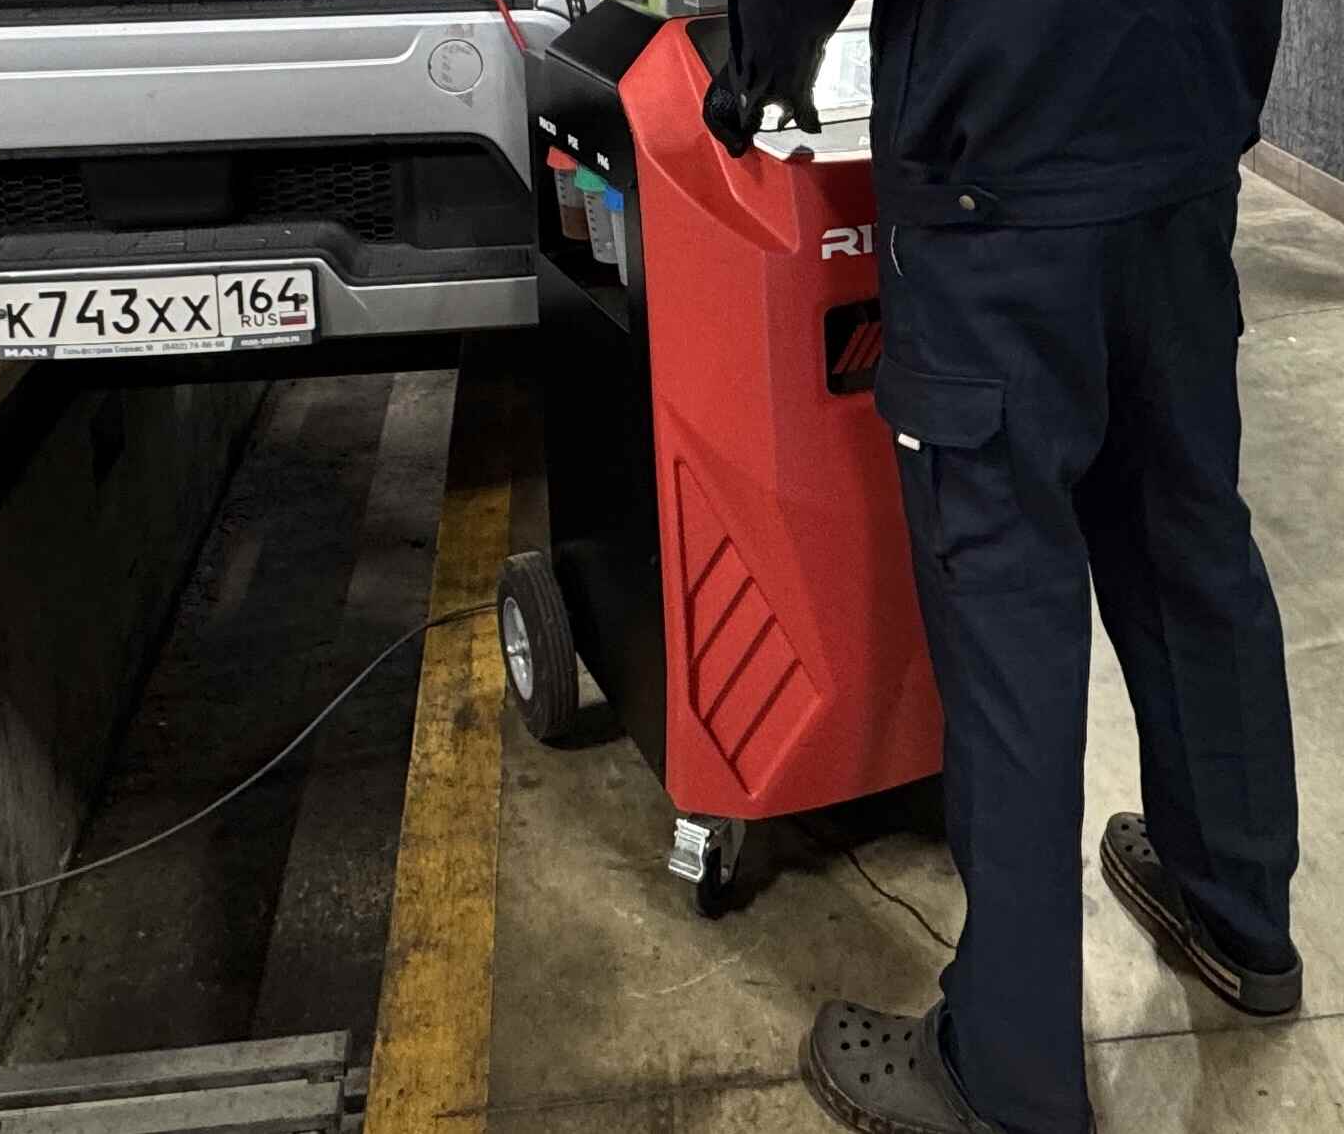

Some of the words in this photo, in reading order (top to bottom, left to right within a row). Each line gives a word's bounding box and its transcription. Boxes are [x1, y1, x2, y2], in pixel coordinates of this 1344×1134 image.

[223, 276, 301, 315] 164
[240, 312, 278, 328] RUS
[3, 347, 48, 358] MAN
